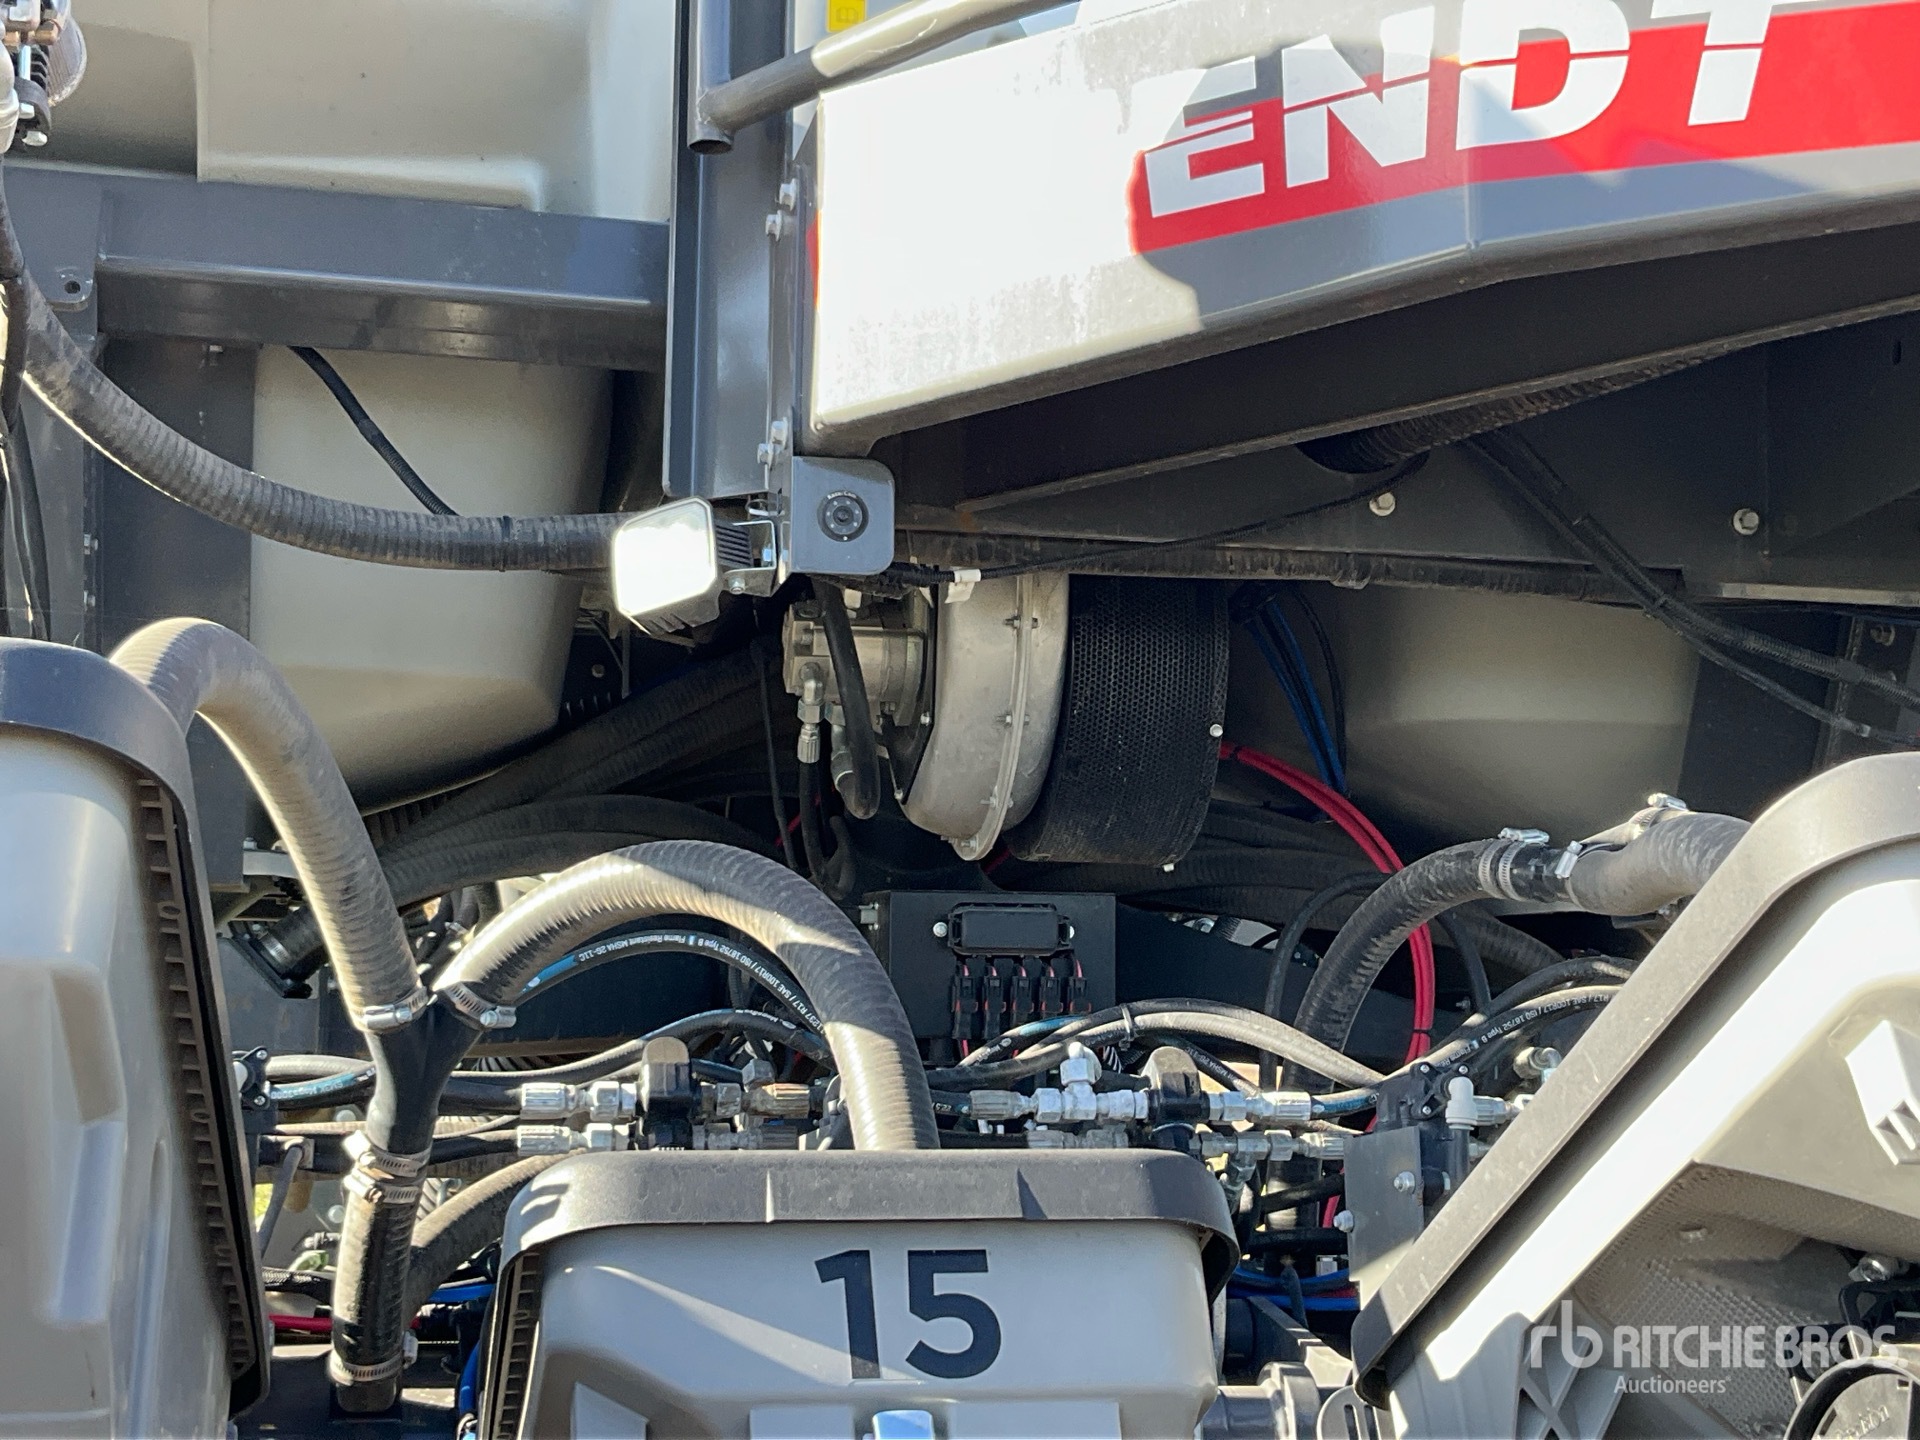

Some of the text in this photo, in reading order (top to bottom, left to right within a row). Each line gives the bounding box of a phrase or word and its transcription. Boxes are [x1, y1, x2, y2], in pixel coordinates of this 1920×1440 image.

[607, 939, 628, 951] MSHA
[629, 934, 663, 944] Resistant
[664, 934, 686, 944] Flame
[697, 938, 704, 947] B
[704, 939, 720, 951] Type
[719, 945, 741, 960] 18752
[740, 955, 752, 968] ISO
[755, 965, 781, 988] 100R17
[777, 984, 792, 998] SAE
[793, 1000, 807, 1014] R17
[1525, 1009, 1538, 1020] ISO
[1502, 1015, 1525, 1030] 18752
[1487, 1026, 1503, 1038] Type
[1481, 1034, 1488, 1044] B
[1450, 1044, 1471, 1062] Flame
[1209, 1061, 1228, 1076] MSHA
[814, 1249, 1001, 1379] 15
